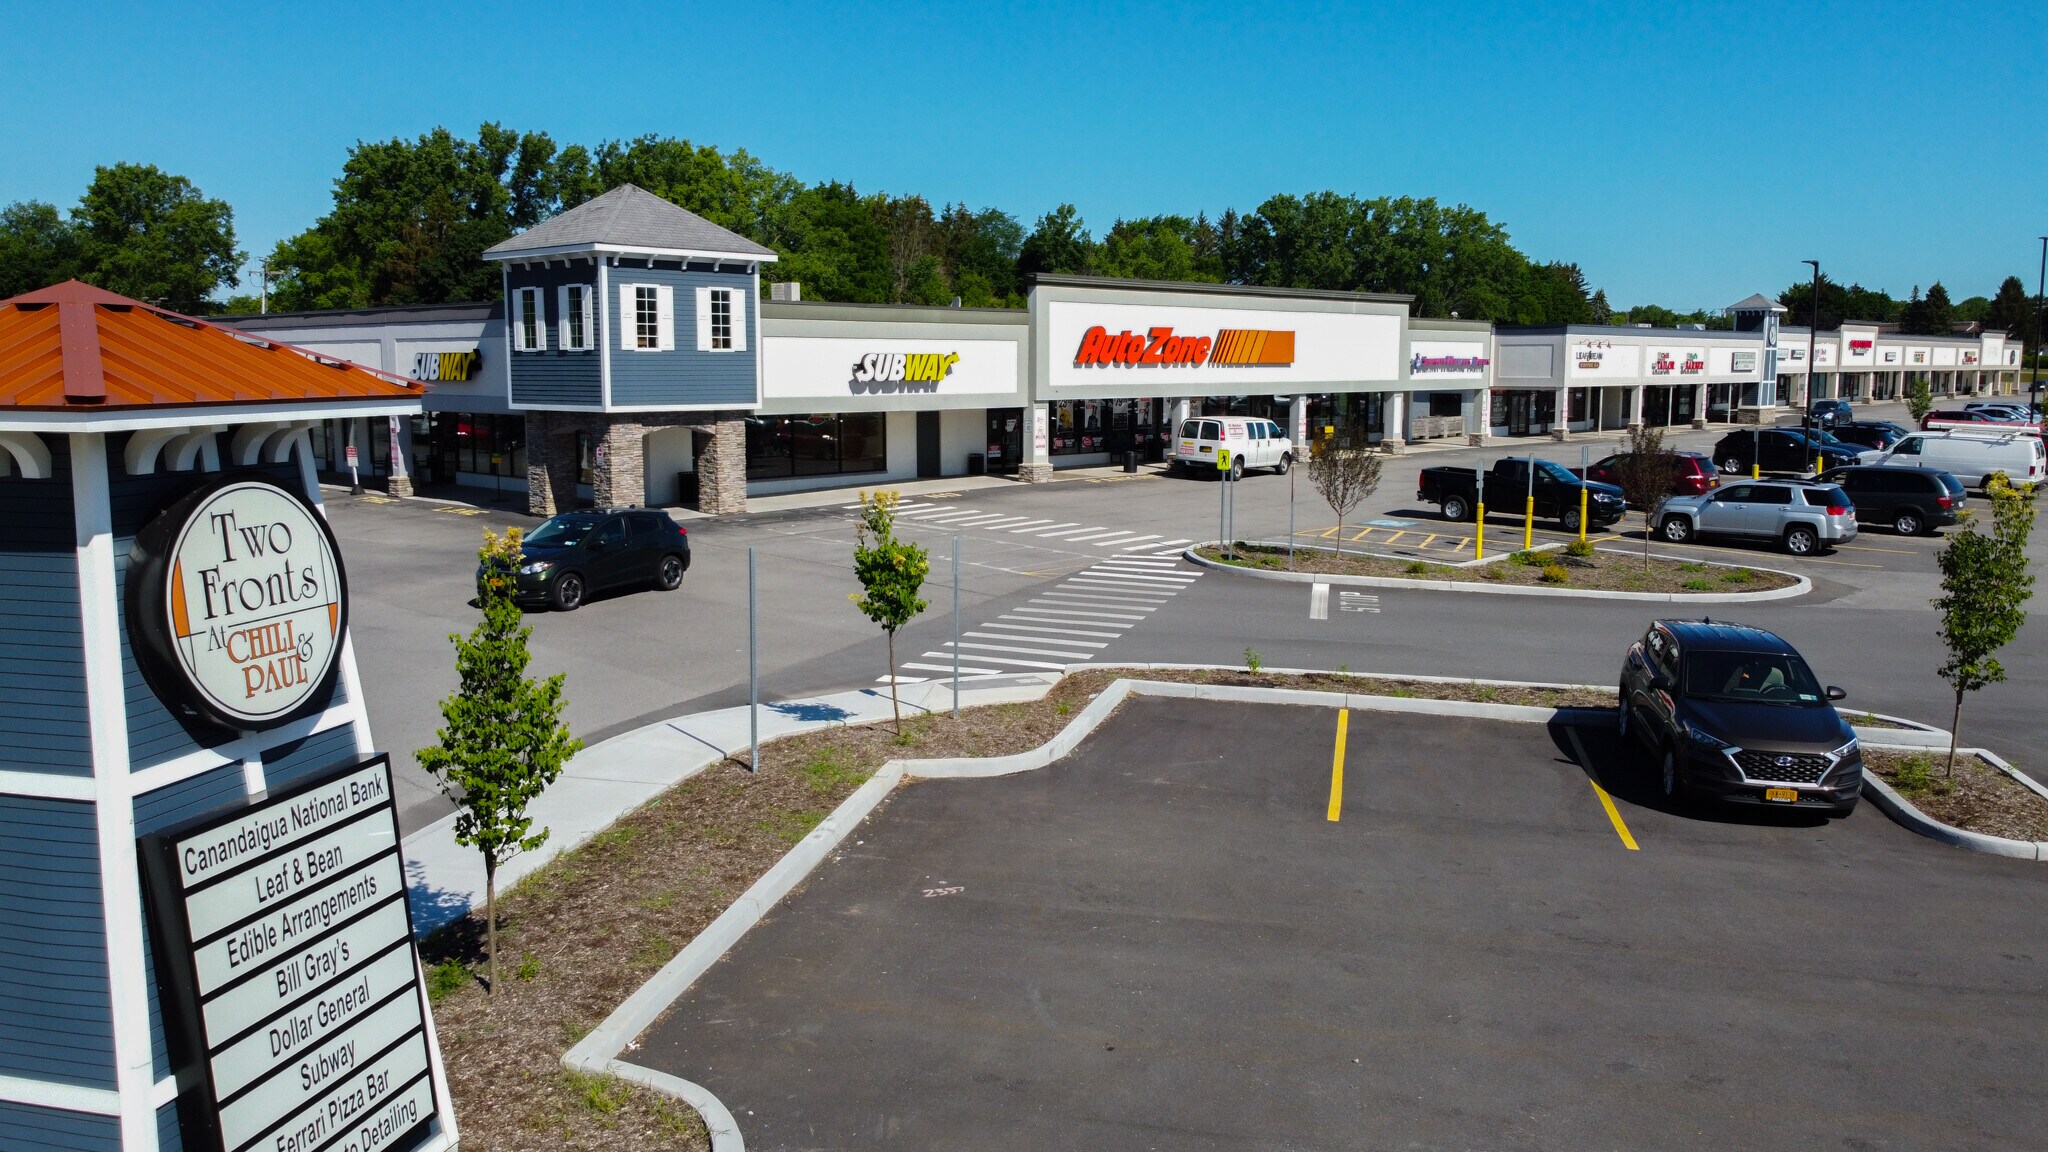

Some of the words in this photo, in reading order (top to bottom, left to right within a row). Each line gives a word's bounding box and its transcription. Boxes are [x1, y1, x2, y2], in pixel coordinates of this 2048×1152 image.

[413, 352, 477, 381] SUBWAY
[853, 352, 960, 383] SUBWAY
[1074, 325, 1212, 365] AutoZone
[210, 509, 292, 563] Two
[198, 558, 319, 620] Fronts
[208, 625, 229, 651] At
[228, 620, 296, 664] CHILI
[295, 632, 314, 662] &
[242, 653, 309, 699] PAUL
[185, 817, 289, 875] Canandaigua
[290, 786, 349, 829] National
[350, 773, 384, 806] Bank
[255, 868, 289, 903] Leaf
[293, 857, 305, 884] &
[308, 845, 344, 879] Bean
[227, 926, 278, 969] Edible
[282, 874, 378, 942] Arrangements
[276, 961, 302, 998] Bill
[304, 938, 350, 982] Gray's
[269, 1014, 313, 1058] Dollar
[317, 975, 371, 1028] General
[300, 1039, 356, 1091] Subway
[276, 1108, 327, 1152] Ferrari
[328, 1086, 365, 1128] Pizza
[366, 1068, 390, 1101] Bar
[360, 1097, 418, 1152] Detailing
